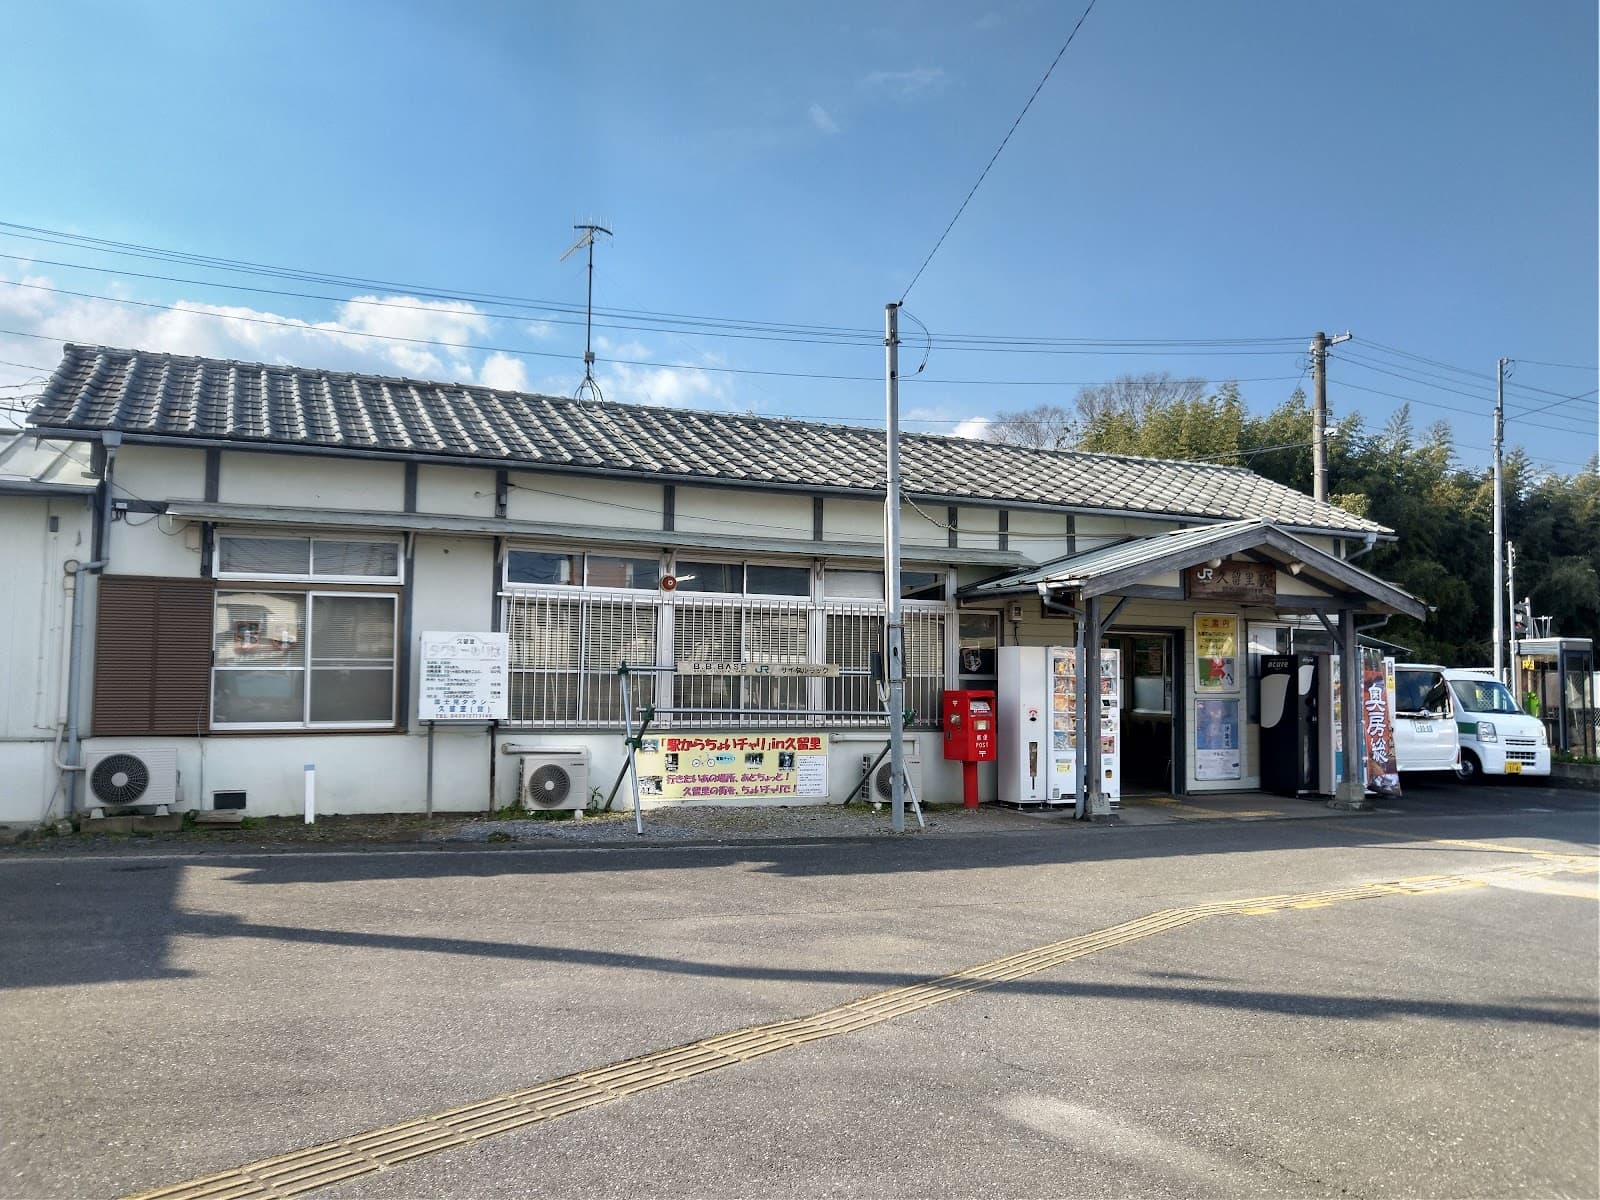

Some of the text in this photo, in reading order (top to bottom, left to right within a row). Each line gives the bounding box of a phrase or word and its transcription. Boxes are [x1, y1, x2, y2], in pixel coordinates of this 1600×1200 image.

[1197, 568, 1213, 580] JR
[754, 665, 770, 674] JR
[1365, 682, 1389, 764] 奥房総
[975, 741, 989, 749] POST
